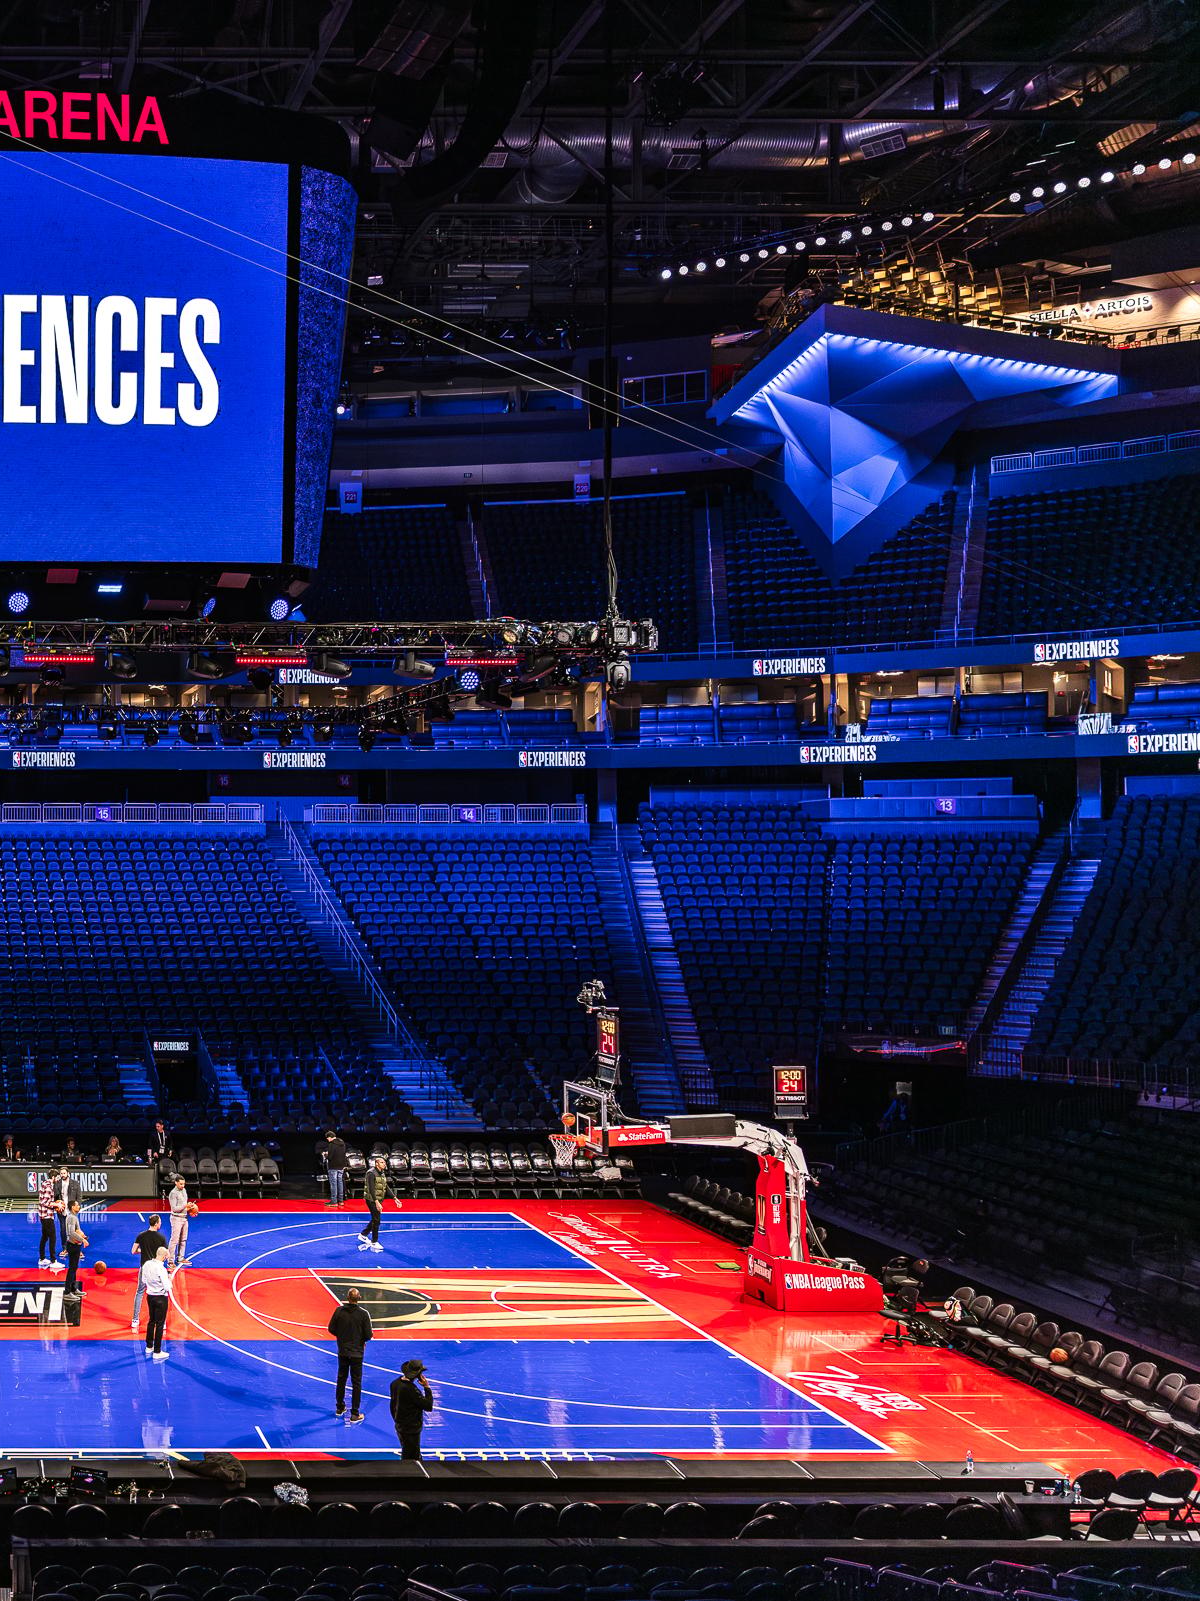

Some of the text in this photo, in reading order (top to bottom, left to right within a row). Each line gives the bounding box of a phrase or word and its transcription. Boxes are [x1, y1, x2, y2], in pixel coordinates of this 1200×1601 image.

[1029, 296, 1150, 322] STELLA ARTOIS
[1045, 638, 1120, 661] EXPERIENCES
[762, 657, 826, 675] EXPERIENCES
[20, 751, 76, 768] EXPERIENCES
[271, 752, 326, 768] EXPERIENCES
[527, 750, 586, 767] EXPERIENCES
[809, 744, 877, 763] EXPERIENCES
[98, 808, 109, 820] 15
[939, 800, 952, 811] 13
[462, 810, 474, 821] 14
[158, 1041, 189, 1051] EXPERIENCES
[602, 1032, 614, 1054] 24
[781, 1070, 801, 1080] 12:00
[782, 1080, 798, 1092] 24
[608, 1246, 682, 1279] ULTRA
[792, 1274, 866, 1291] NBA League Pass
